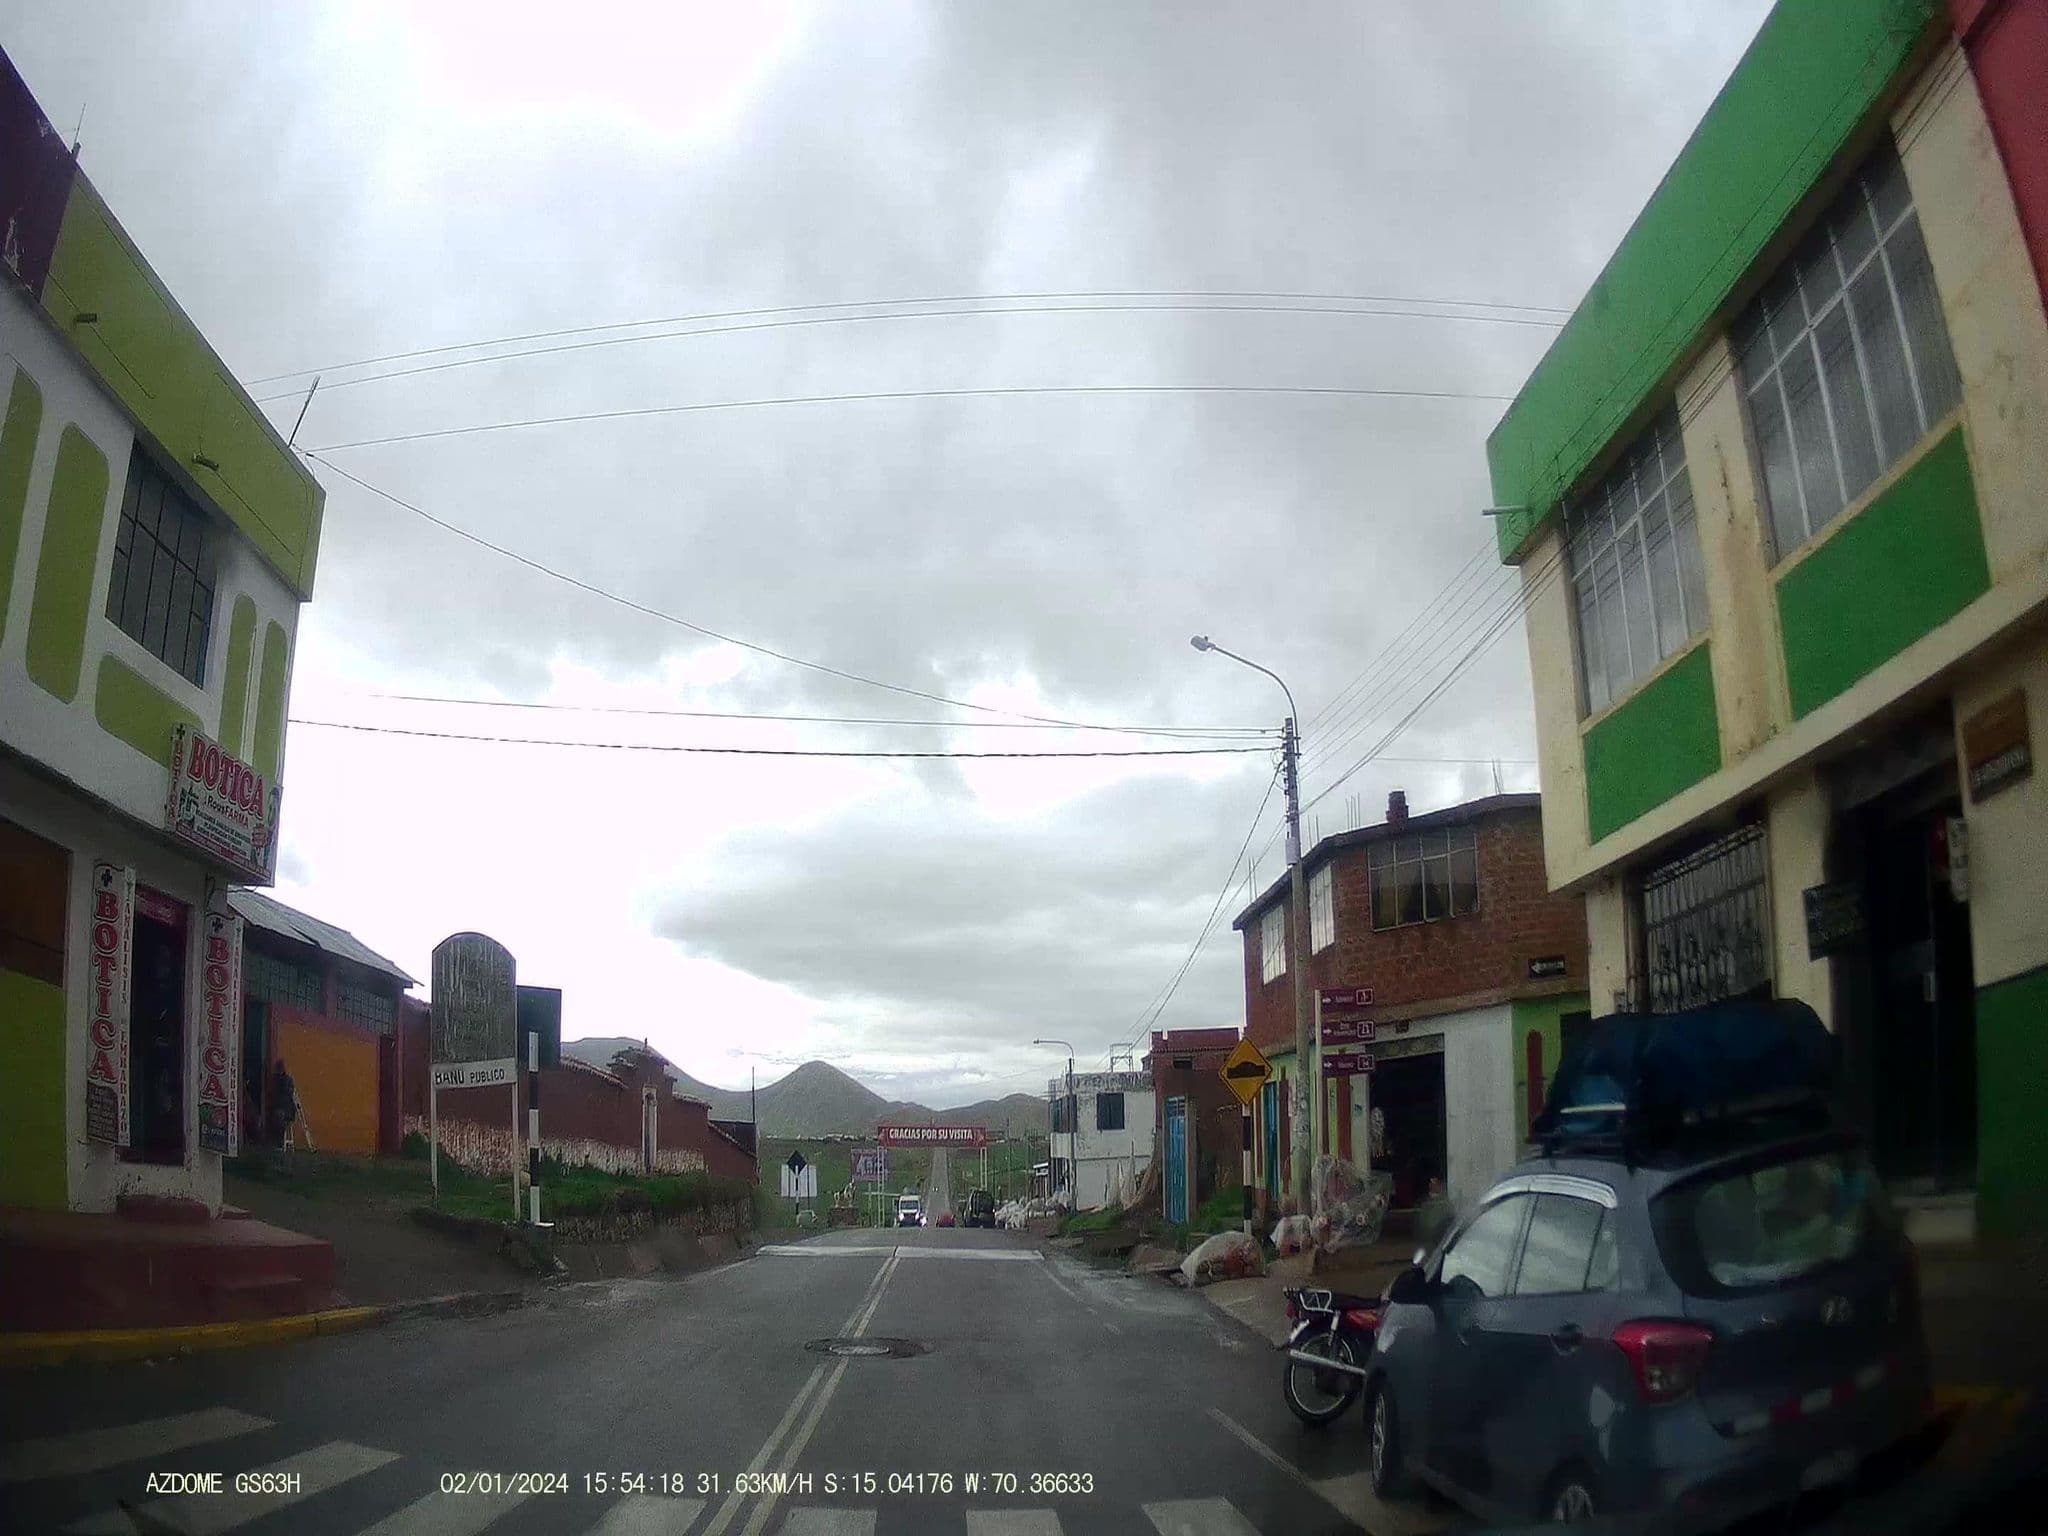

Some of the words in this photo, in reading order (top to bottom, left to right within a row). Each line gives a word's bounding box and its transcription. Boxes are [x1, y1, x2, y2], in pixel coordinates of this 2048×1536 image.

[188, 733, 264, 819] BOTICA
[91, 890, 119, 1082] BOTICA
[202, 937, 230, 1101] BOTICA
[470, 1068, 505, 1083] PUBLICO
[889, 1128, 921, 1140] GRACIAS
[922, 1128, 937, 1140] POR
[938, 1128, 948, 1140] SU
[949, 1128, 973, 1140] VISITA
